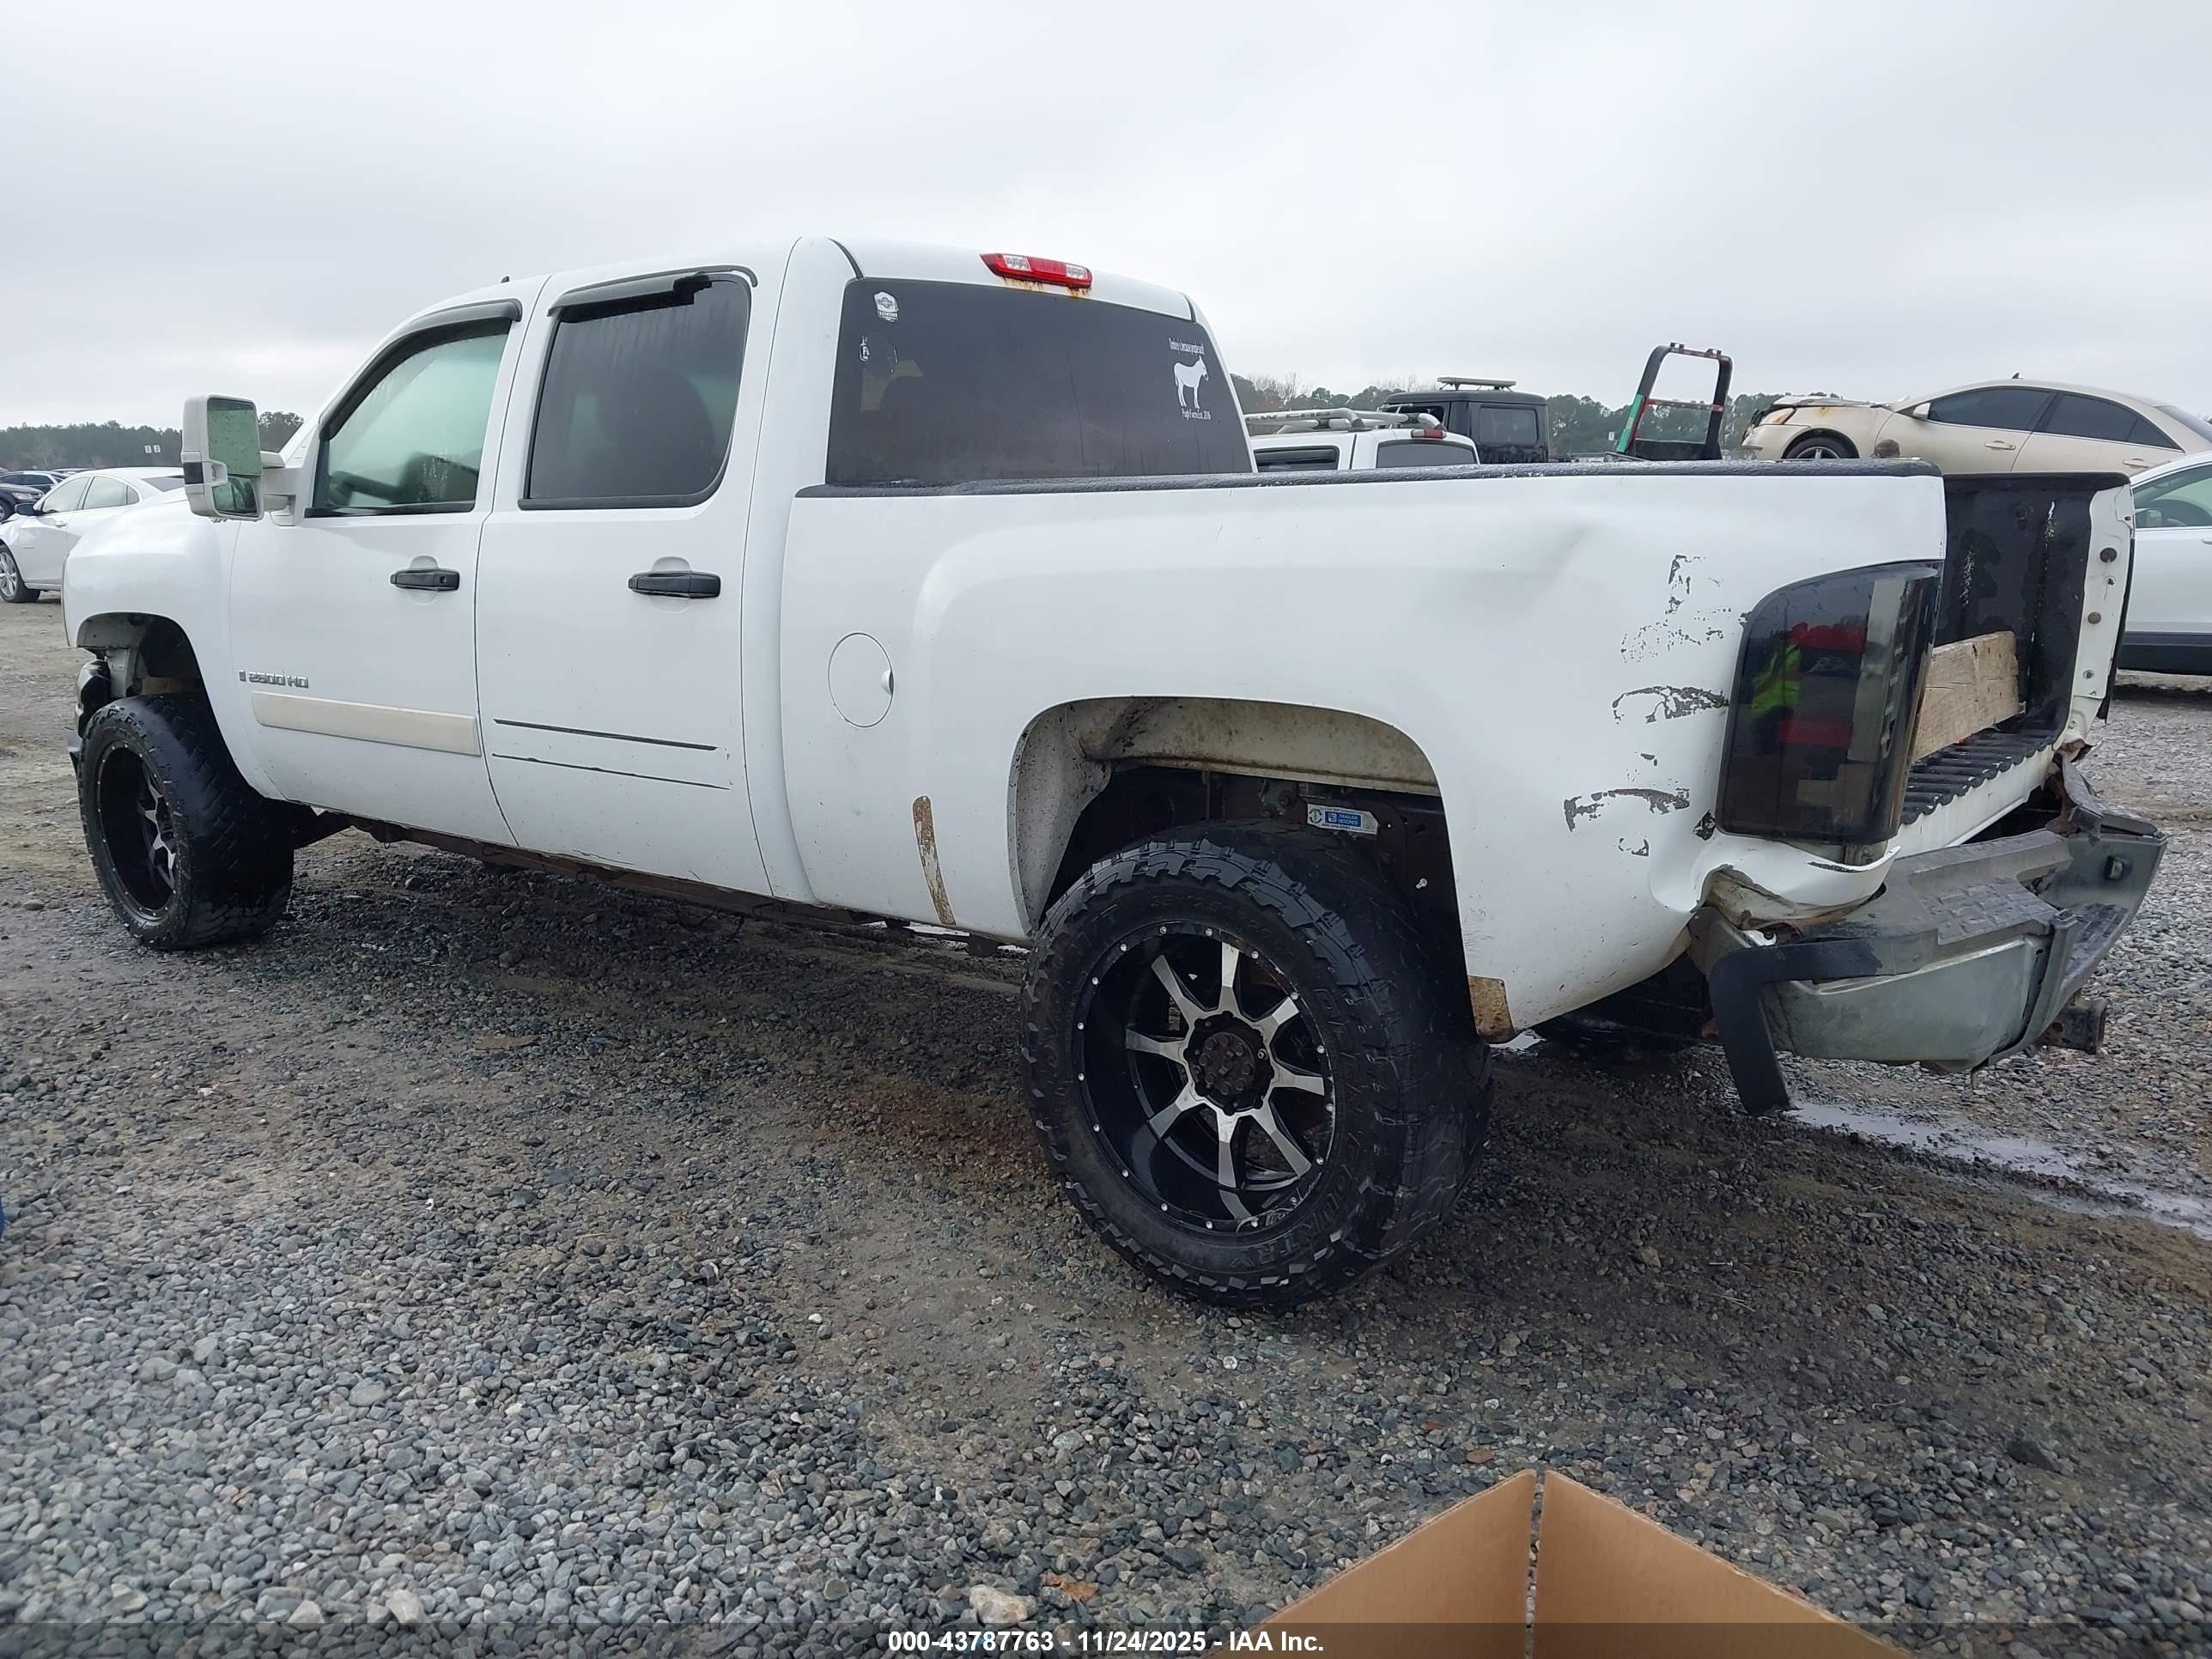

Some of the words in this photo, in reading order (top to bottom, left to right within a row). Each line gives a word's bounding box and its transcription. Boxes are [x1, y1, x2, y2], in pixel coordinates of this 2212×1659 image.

[248, 672, 286, 686] 2500
[287, 675, 309, 689] HD
[1338, 812, 1358, 821] TRAILER
